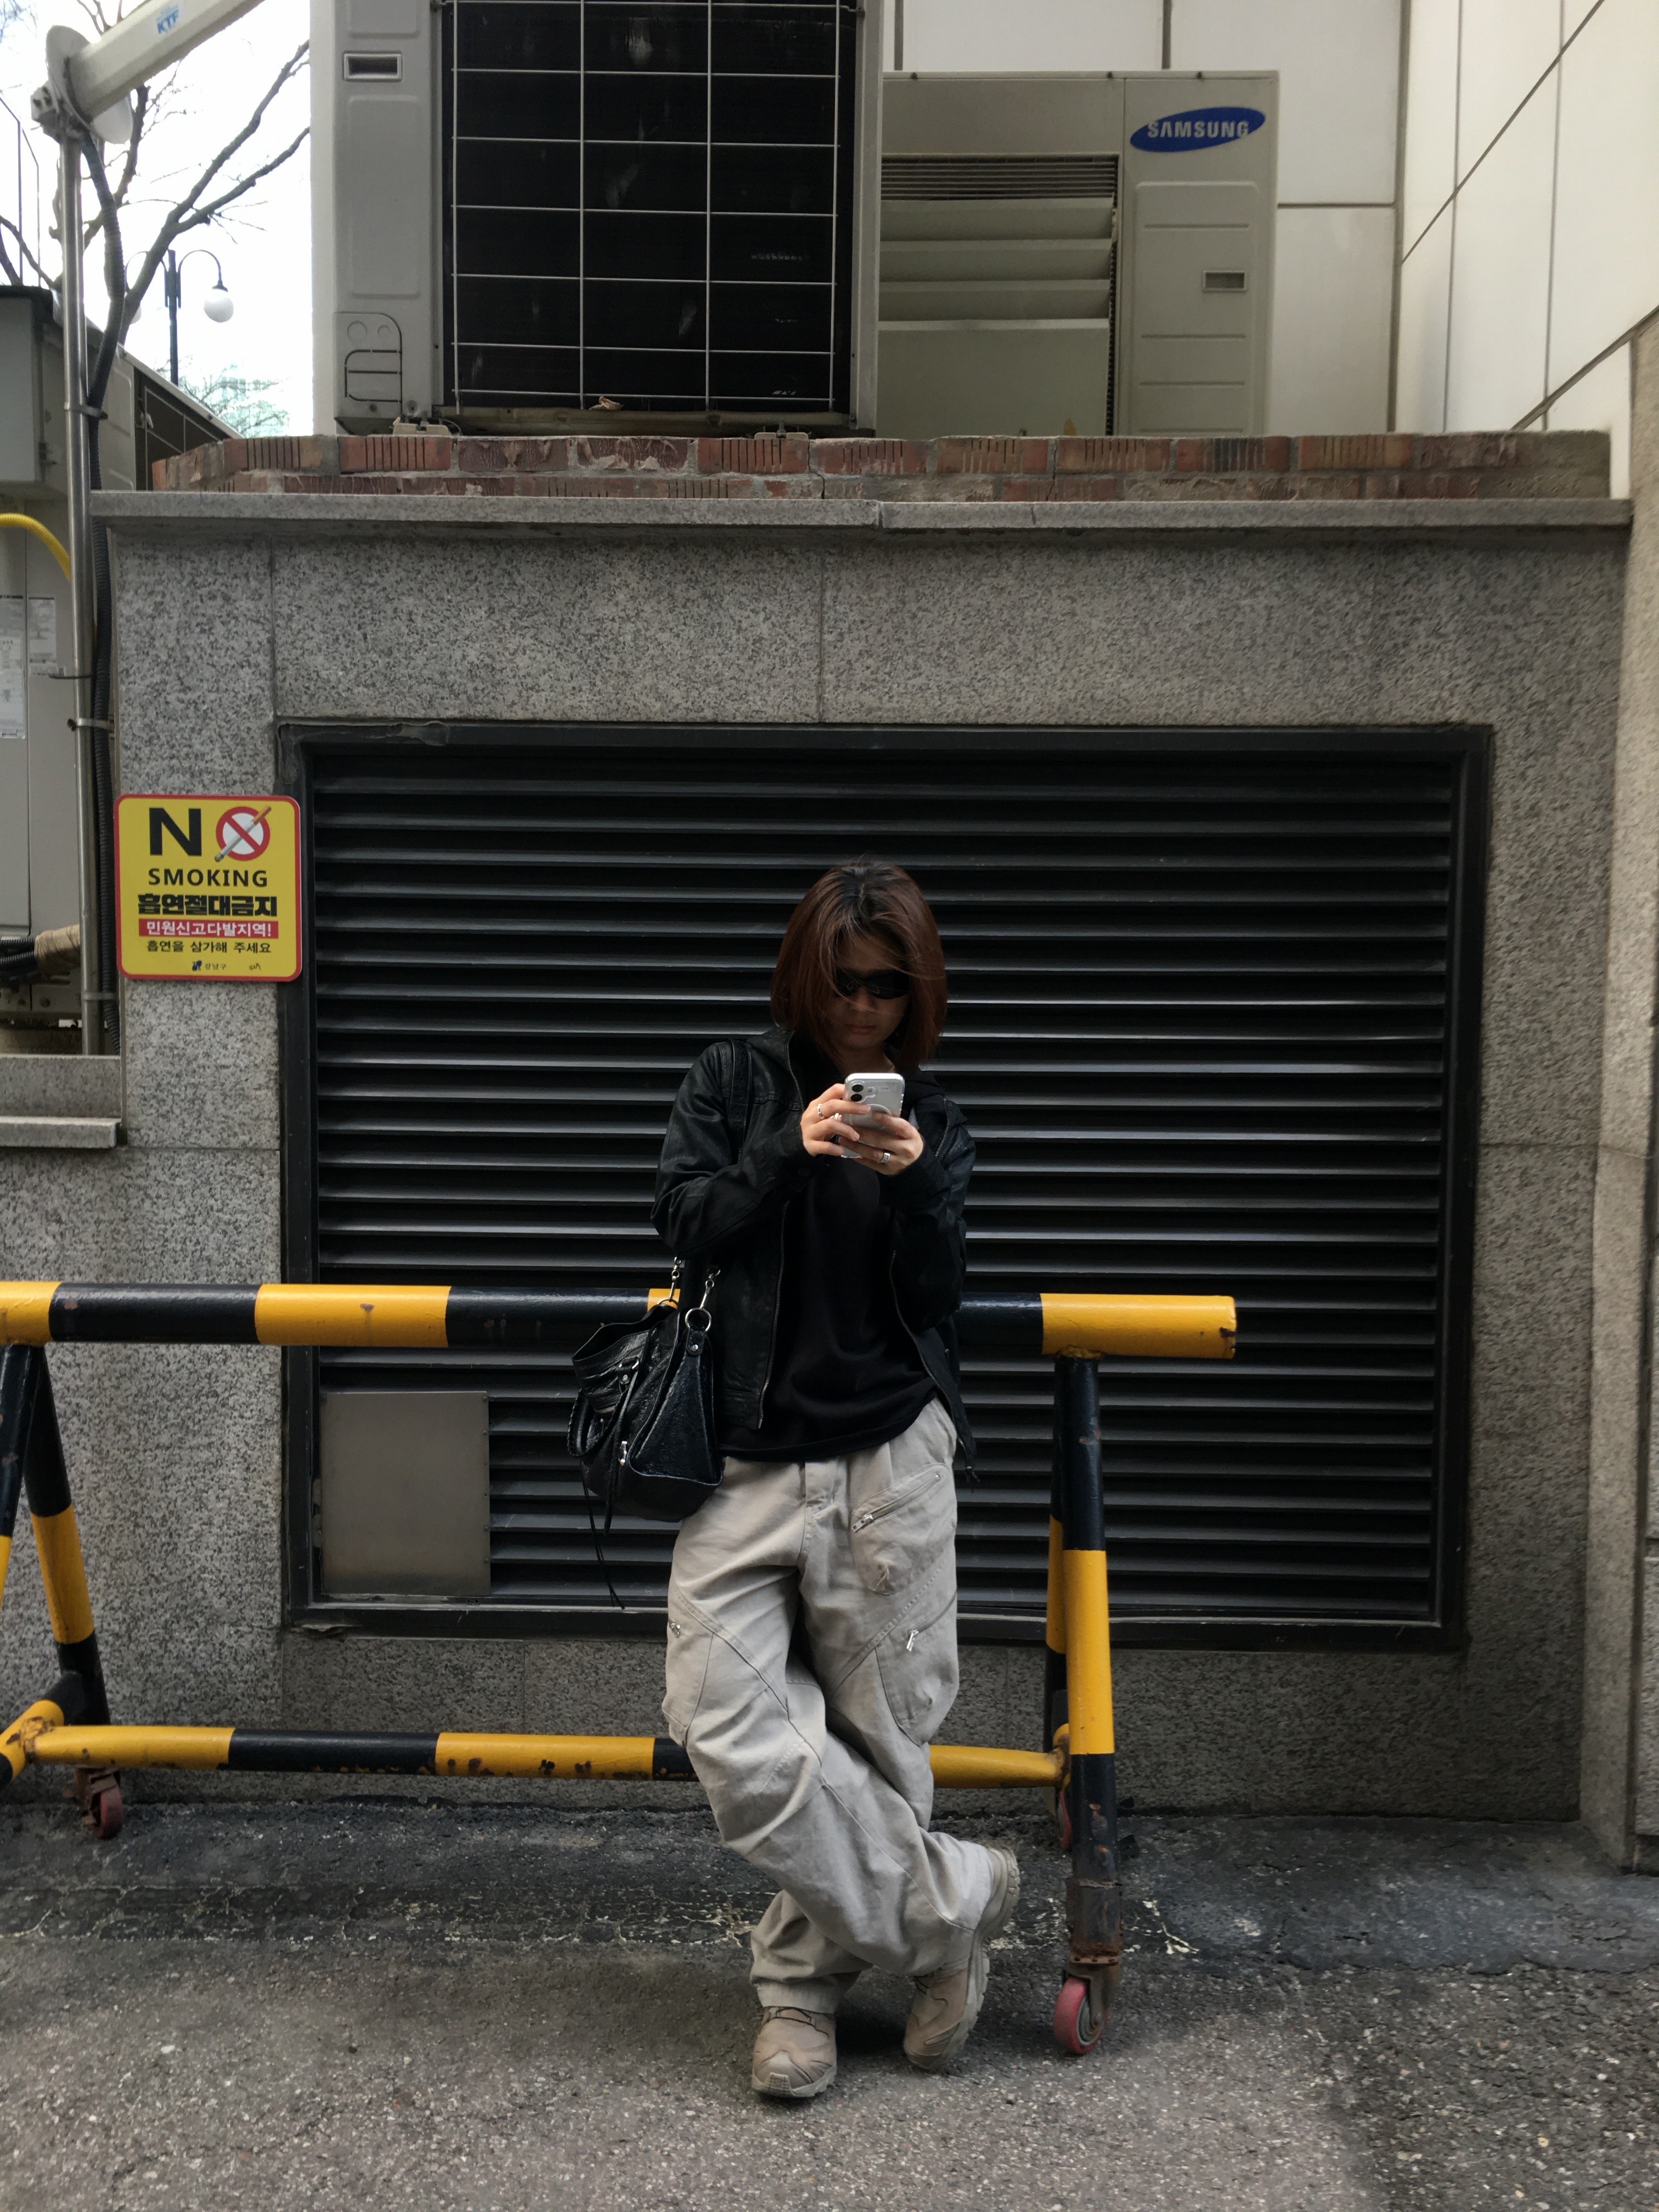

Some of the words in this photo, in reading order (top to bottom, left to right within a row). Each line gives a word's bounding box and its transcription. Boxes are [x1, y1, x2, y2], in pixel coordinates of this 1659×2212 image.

[1147, 120, 1249, 138] SAMSUNG
[148, 868, 268, 887] SMOKING
[138, 893, 277, 917] 흡연절대금지
[146, 921, 272, 938] 민원신고다발지역!
[146, 940, 184, 952] 흡연을
[190, 941, 228, 953] 삼가해
[234, 942, 272, 954] 주세요
